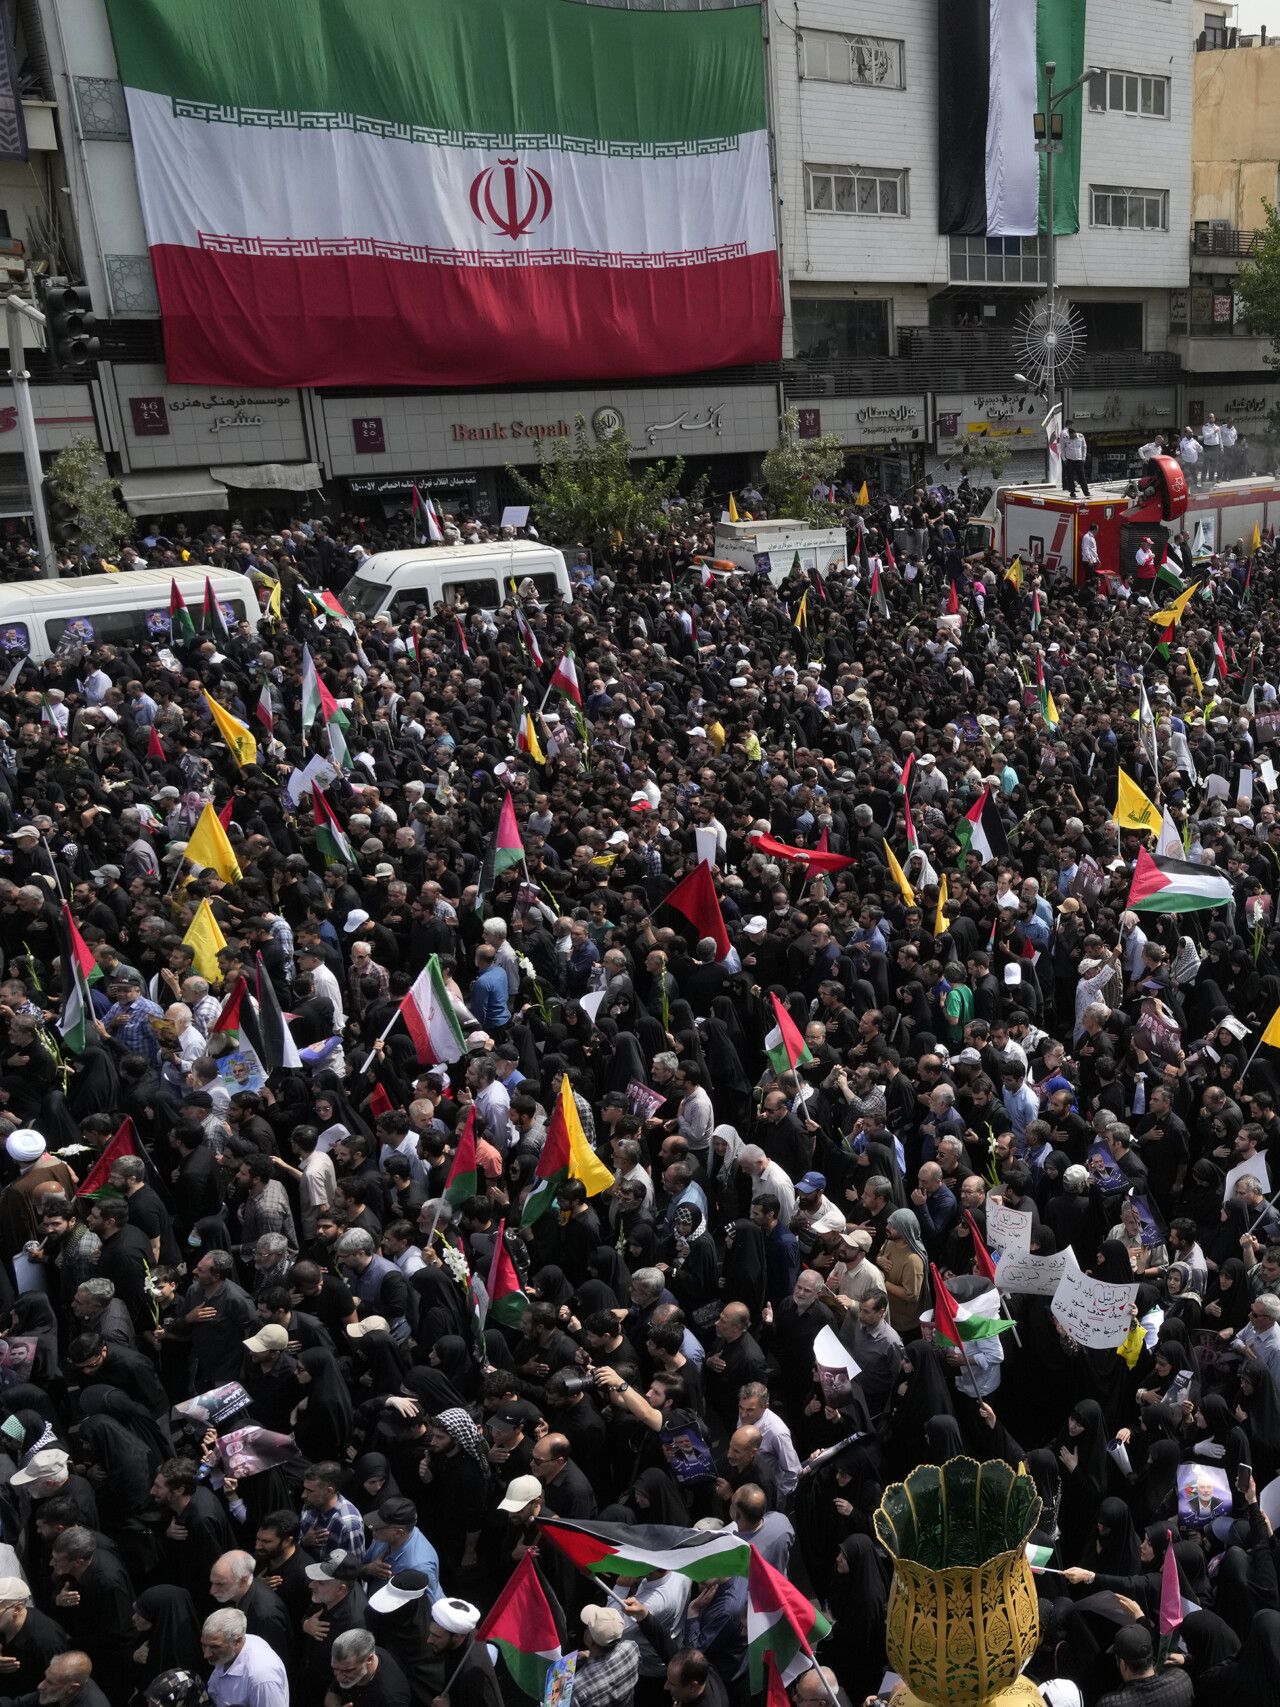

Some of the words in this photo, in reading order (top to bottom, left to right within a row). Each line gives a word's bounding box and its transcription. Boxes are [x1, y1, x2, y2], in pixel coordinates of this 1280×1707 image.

[140, 402, 158, 410] 46
[169, 398, 202, 411] هنری
[202, 395, 247, 409] فرهنگی
[247, 396, 290, 407] موسسه
[857, 405, 918, 423] هزاردستان
[210, 409, 264, 433] مشعر
[361, 421, 377, 430] 45
[453, 422, 507, 442] Bank
[511, 420, 571, 441] Sepah
[645, 411, 689, 445] سپه
[417, 479, 432, 489] تهران
[1031, 1258, 1045, 1267] فقط
[1082, 1287, 1093, 1298] باید
[1071, 1299, 1085, 1308] شود
[1087, 1307, 1105, 1316] حذف
